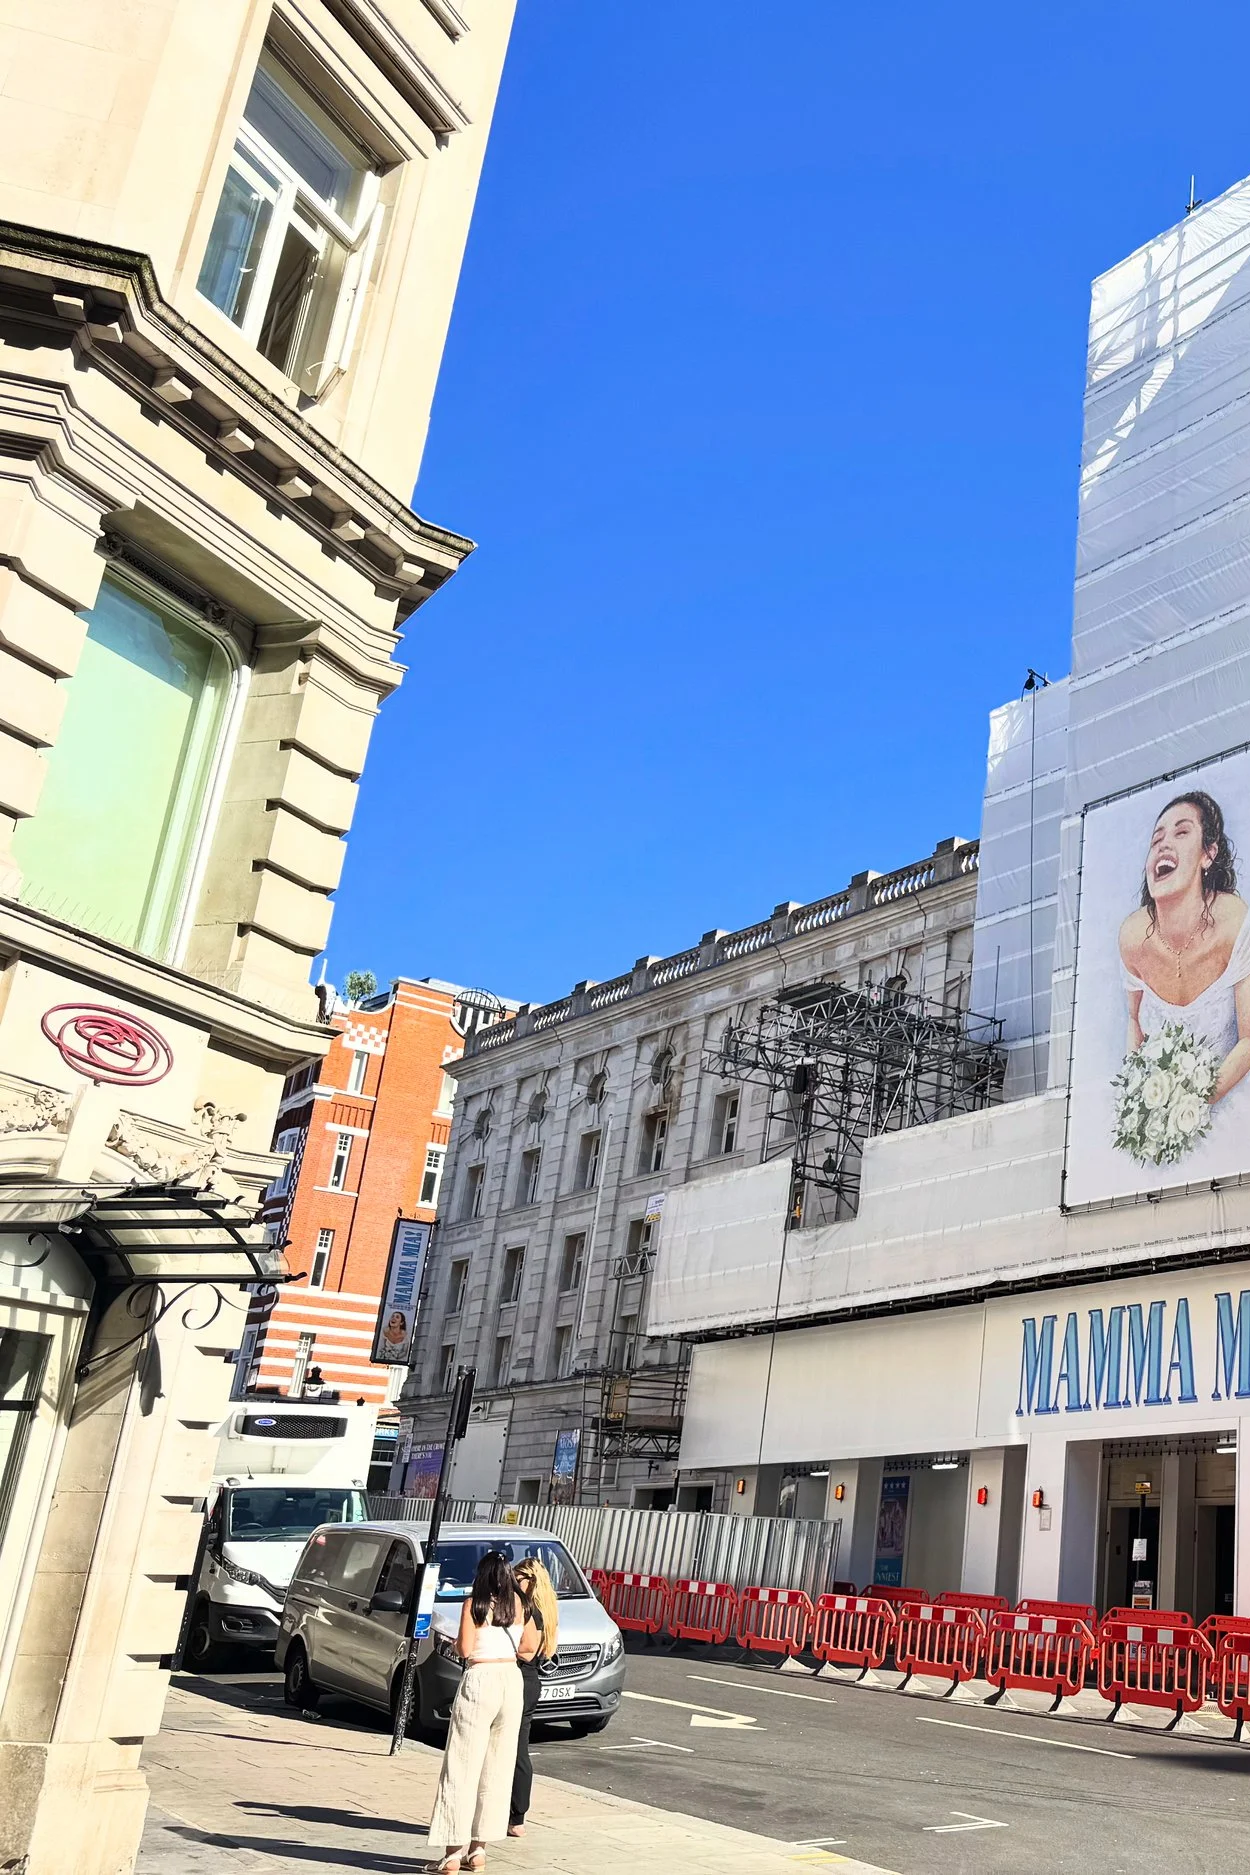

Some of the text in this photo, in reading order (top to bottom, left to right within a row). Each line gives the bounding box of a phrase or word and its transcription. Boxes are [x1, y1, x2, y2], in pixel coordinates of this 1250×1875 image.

[401, 1230, 423, 1259] MIA!
[393, 1260, 418, 1305] MAMMA
[1016, 1297, 1198, 1416] MAMMA
[551, 1687, 572, 1698] OSX
